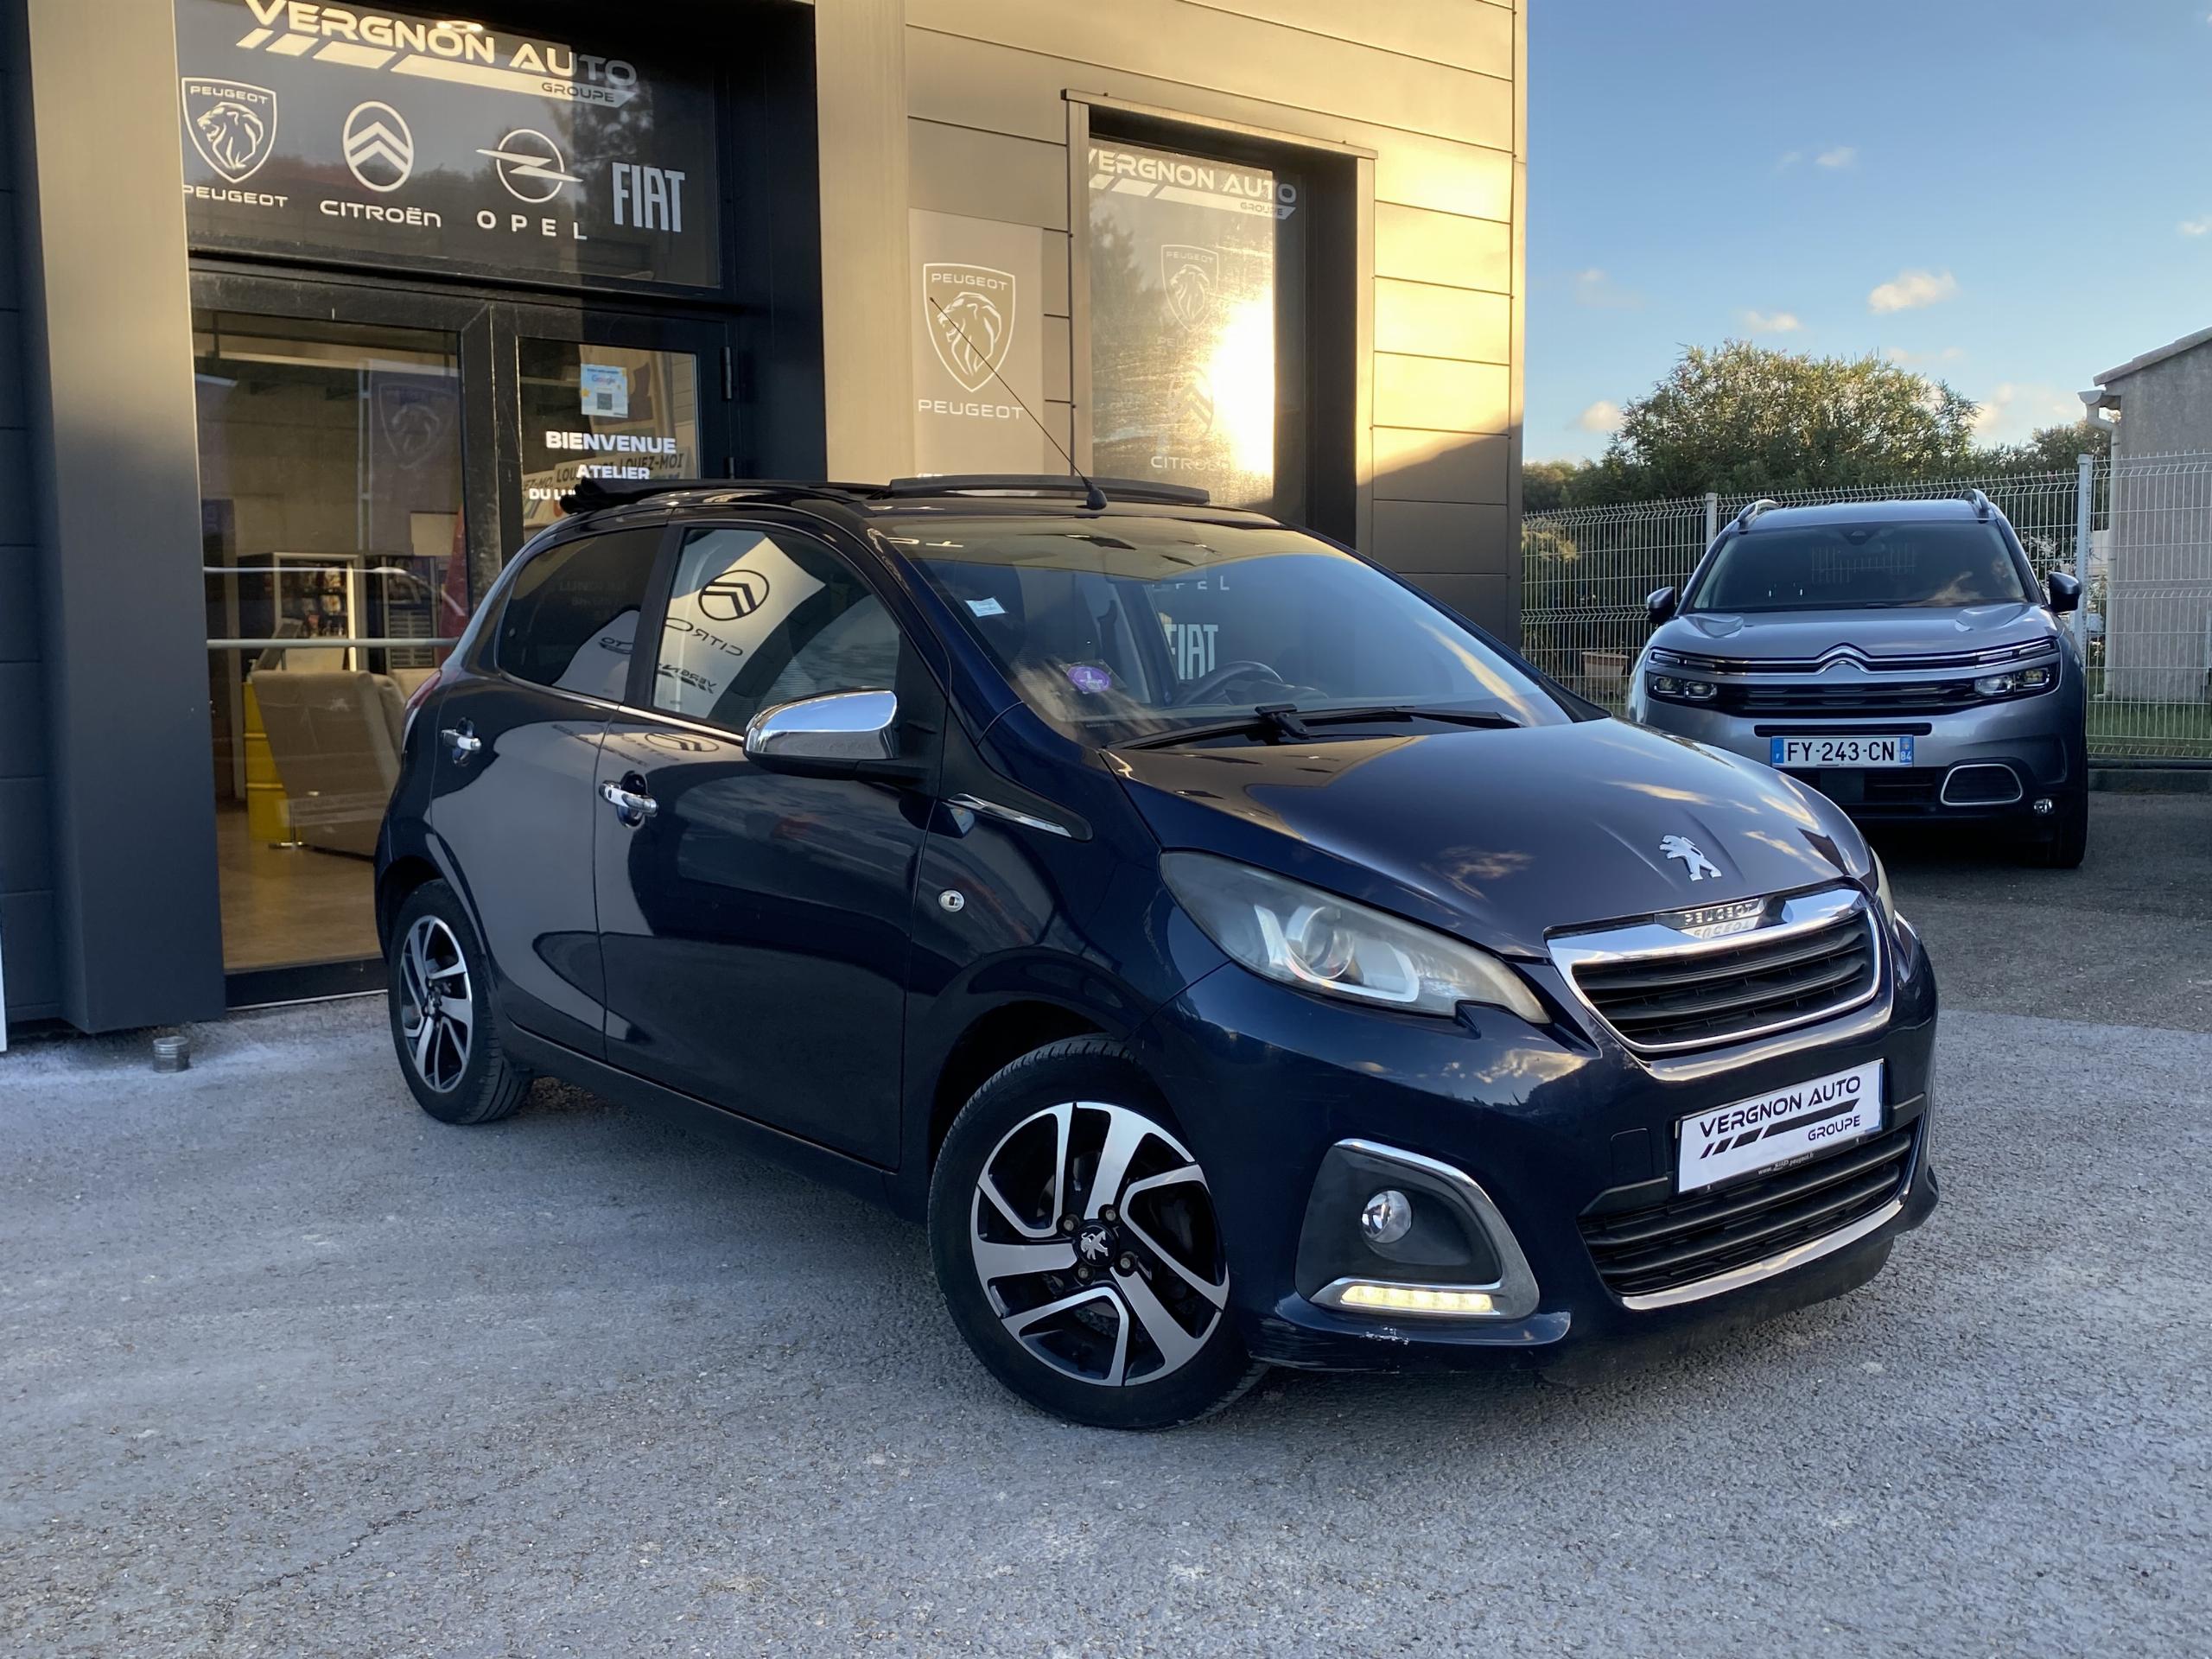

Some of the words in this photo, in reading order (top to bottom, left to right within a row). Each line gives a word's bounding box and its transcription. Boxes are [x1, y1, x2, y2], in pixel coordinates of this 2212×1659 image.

[245, 0, 495, 63] VERGNON
[510, 43, 637, 86] AUTO
[190, 86, 269, 104] PEUGEOT
[541, 82, 615, 102] GROUPE
[612, 162, 685, 232] FIAT
[1221, 172, 1297, 203] AUTO
[476, 210, 588, 240] OPEL
[1166, 251, 1213, 263] PEUGEOT
[931, 273, 1007, 290] PEUGEOT
[918, 399, 1024, 419] PEUGEOT
[545, 431, 677, 454] BIENVENUE
[575, 464, 650, 480] ATELIER
[528, 488, 551, 499] DU
[1787, 741, 1895, 761] FY-243-CN
[1900, 751, 1912, 761] 84
[1684, 903, 1753, 925] PEUGEOT
[1700, 1092, 1802, 1138] VERGNON
[1808, 1076, 1860, 1107] AUTO
[1808, 1115, 1860, 1141] GROUPE
